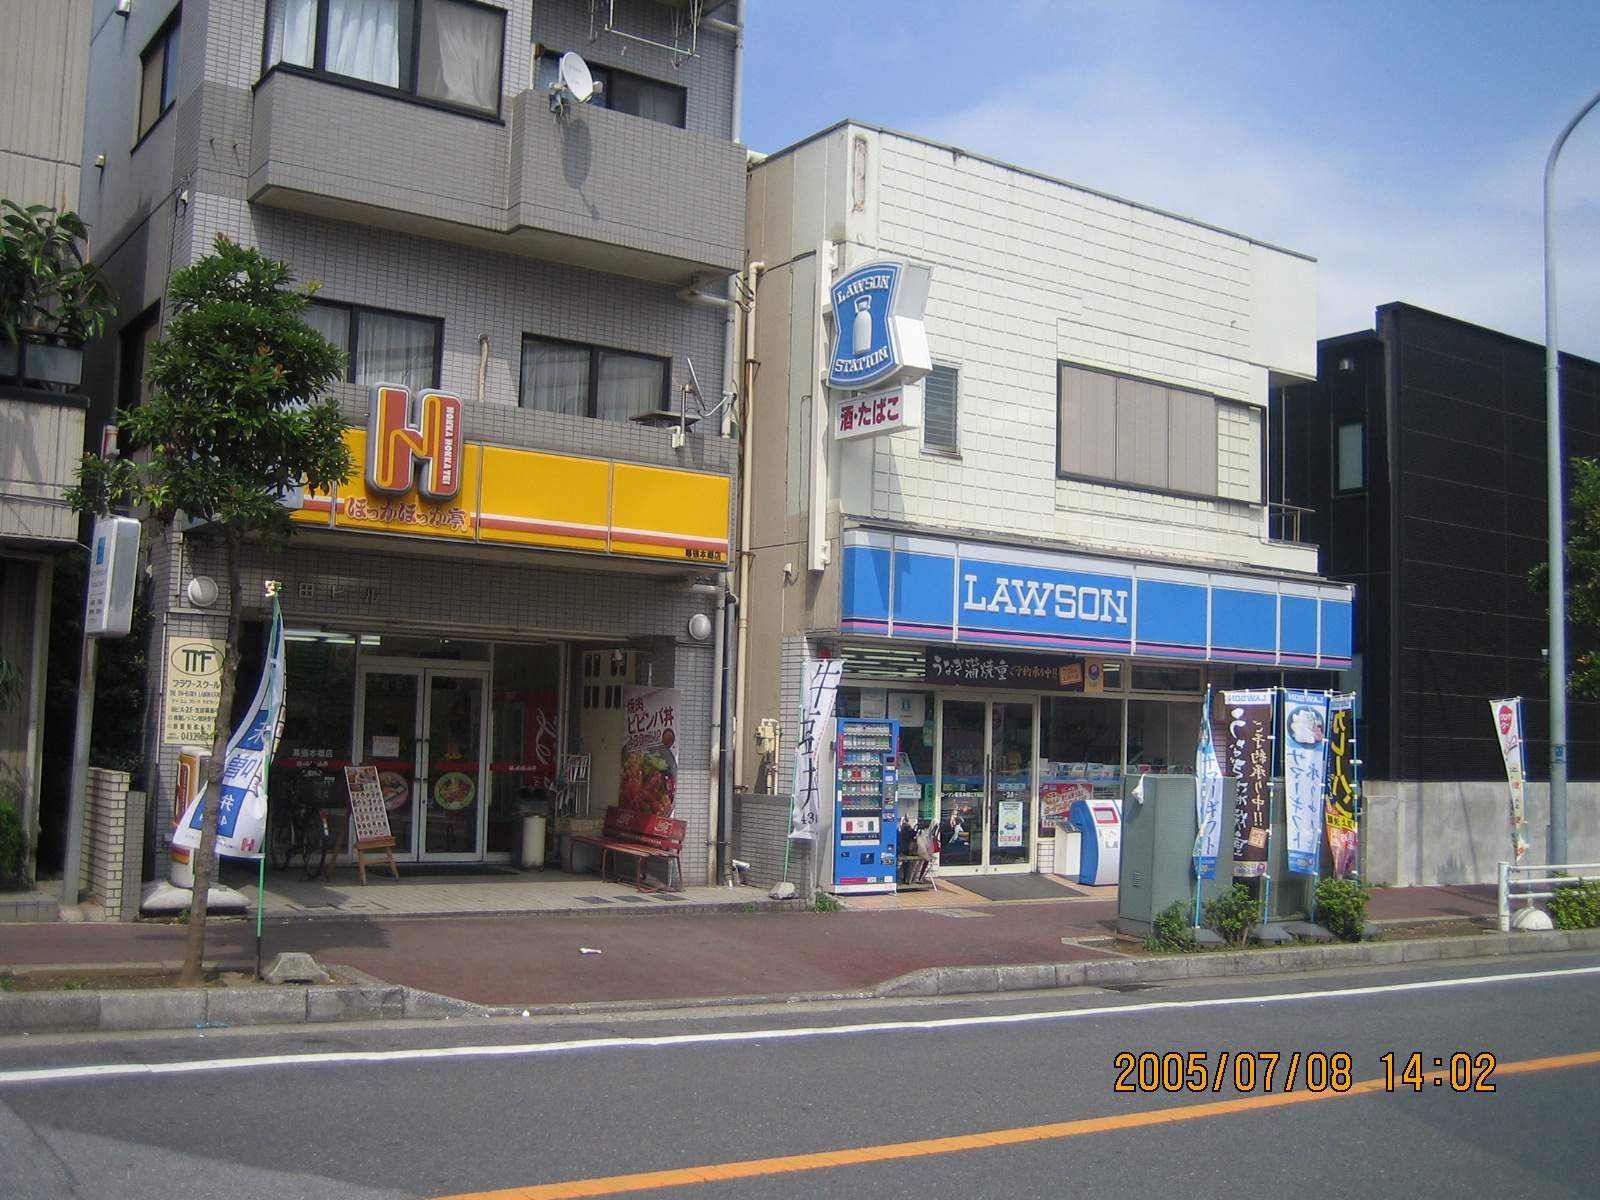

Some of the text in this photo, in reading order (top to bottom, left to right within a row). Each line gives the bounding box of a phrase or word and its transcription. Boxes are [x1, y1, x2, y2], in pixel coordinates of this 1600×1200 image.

[837, 275, 891, 305] LAWSON
[834, 345, 889, 374] STATION
[442, 406, 455, 485] HOKKA HOKKA TEI
[347, 497, 468, 532] ほっかほっか亭
[963, 574, 1129, 625] LAWSON
[172, 679, 221, 689] フラワースクール
